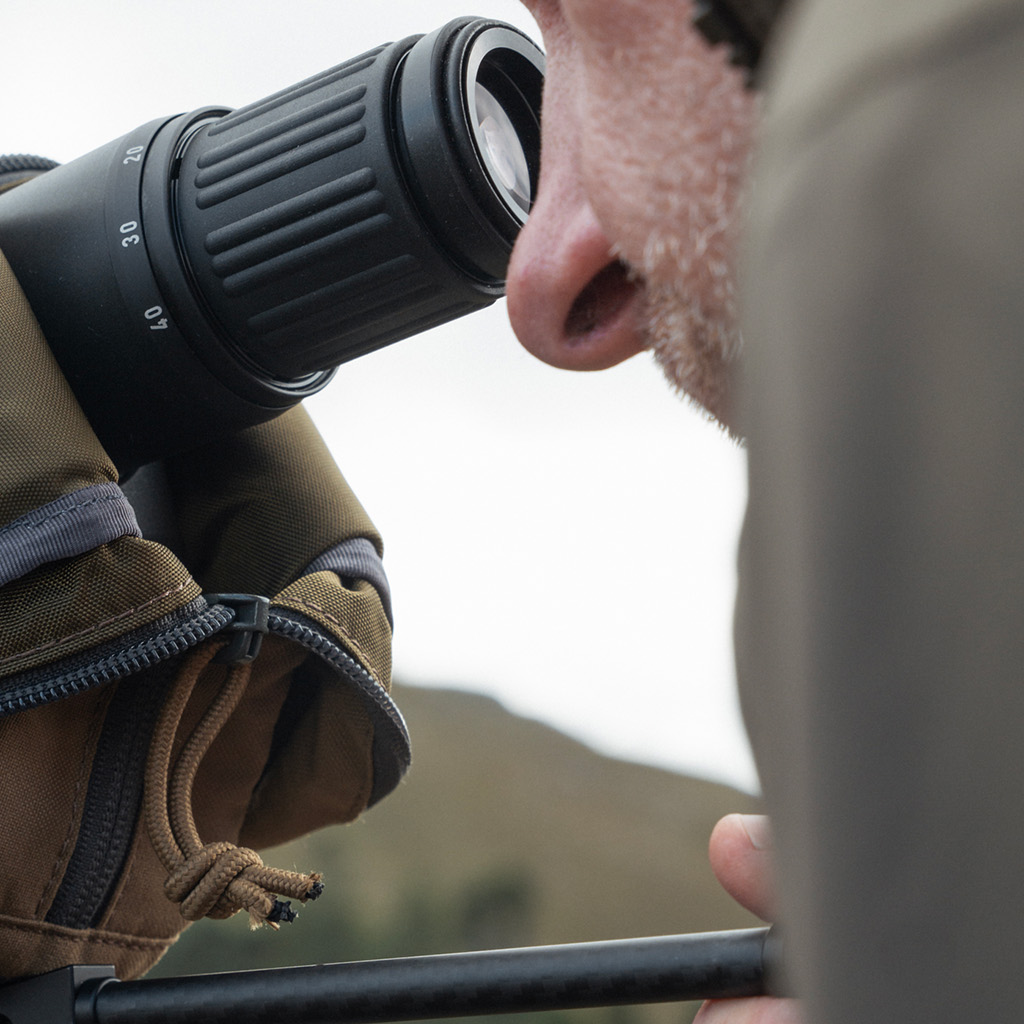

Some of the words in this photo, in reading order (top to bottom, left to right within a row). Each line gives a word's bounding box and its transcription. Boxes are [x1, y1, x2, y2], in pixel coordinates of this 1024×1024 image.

[122, 144, 144, 165] 20
[119, 220, 140, 247] 30
[144, 305, 168, 331] 40
